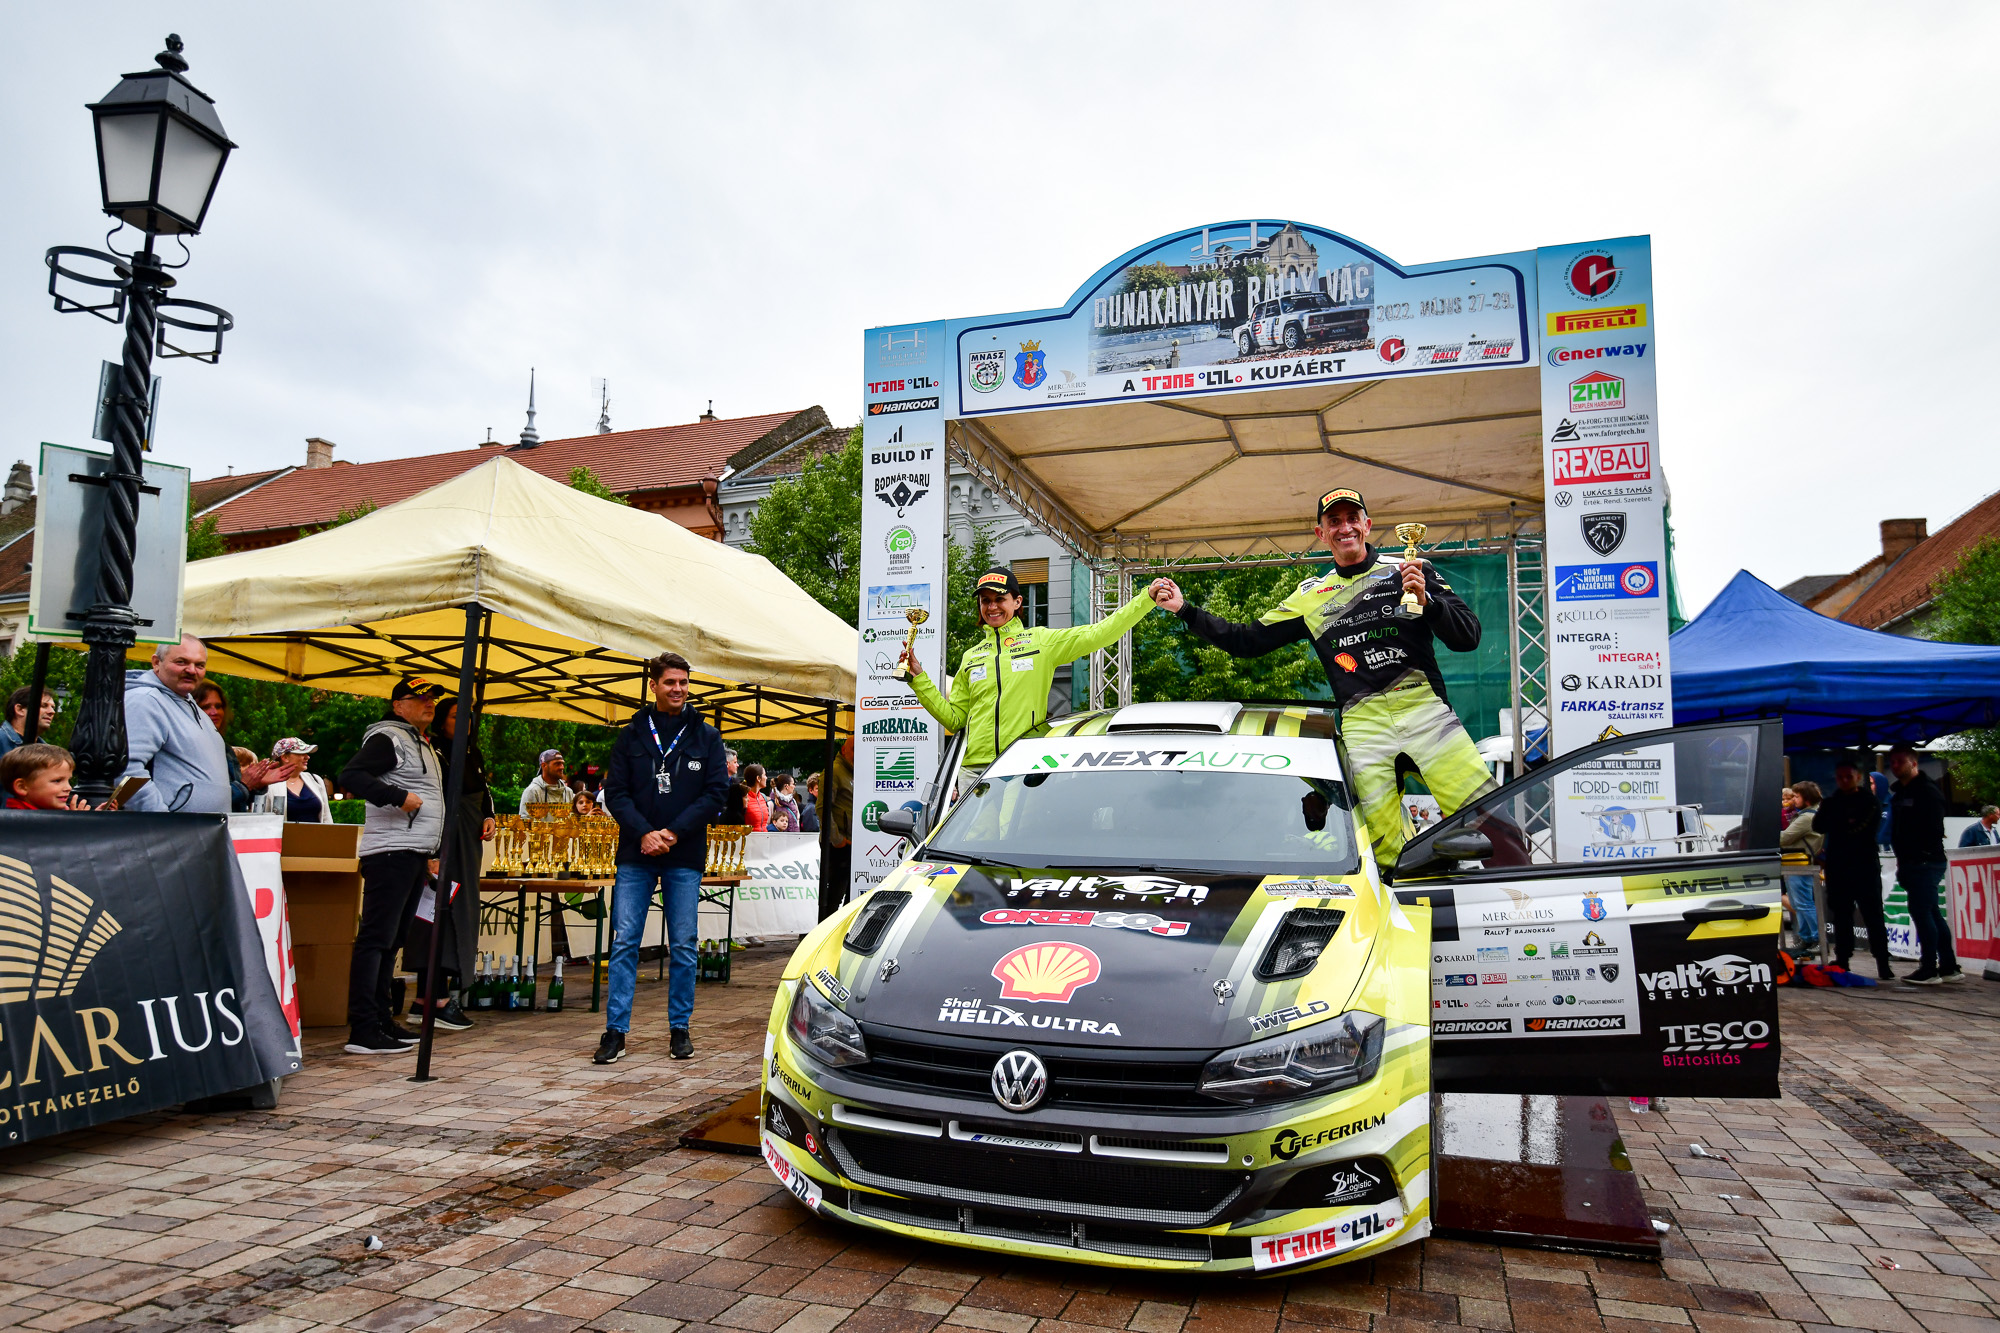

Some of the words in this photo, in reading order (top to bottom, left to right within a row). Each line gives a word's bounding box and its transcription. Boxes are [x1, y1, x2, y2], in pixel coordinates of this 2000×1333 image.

[1094, 279, 1235, 328] DUNAKANYAR
[1248, 271, 1317, 319] RALLY
[1376, 302, 1414, 322] 2022.
[1556, 308, 1638, 332] PIRELLI
[970, 351, 1005, 362] MNASZ
[1432, 351, 1460, 360] RALLY
[1483, 346, 1512, 355] RALLY
[1559, 343, 1647, 362] enerway
[1122, 380, 1136, 392] A
[1251, 358, 1346, 381] KUPÁÉRT
[1572, 381, 1621, 402] ZHW
[1572, 401, 1594, 410] ZEMPLÉN
[1594, 399, 1623, 408] HARD-WORK
[1578, 416, 1619, 426] FA-FORG-TECH
[1583, 427, 1646, 438] www.faforgtech.hu
[871, 450, 916, 465] BUILD
[920, 448, 934, 461] IT
[1554, 446, 1646, 480] REXBAU
[874, 472, 930, 493] BODNÁR-DARU
[1582, 488, 1612, 497] LUKÁCS
[1614, 486, 1624, 495] ÉS
[1625, 484, 1653, 493] TAMÁS
[1623, 495, 1653, 503] Szeretet.
[1584, 515, 1622, 523] PEUGEOT
[1583, 567, 1600, 576] HOGY
[1583, 574, 1615, 582] MINDENKI
[1577, 581, 1615, 590] HAZAÉRJEN!
[1563, 608, 1607, 623] KÜLLŐ
[1338, 626, 1399, 648] NEXTAUTO
[1557, 632, 1611, 643] INTEGRA
[1364, 646, 1408, 665] HELIX
[1586, 674, 1663, 689] KARADI
[865, 697, 889, 707] DÓSA
[1560, 700, 1665, 712] FARKAS-transz
[1607, 712, 1648, 720] SZÁLLÍTÁSI
[862, 717, 928, 735] HERBATÁR
[688, 761, 702, 771] FIA
[1072, 750, 1292, 770] NEXTAUTO
[1603, 760, 1624, 769] WELL
[1626, 760, 1642, 769] BAU
[1644, 760, 1660, 769] KFT.
[876, 780, 915, 789] PERLA-X
[1573, 780, 1660, 795] NORD-ORIENT
[1582, 845, 1626, 858] EVIZA
[1631, 846, 1657, 858] KFT
[1662, 873, 1771, 896] iWELD
[1007, 890, 1205, 906] SECURITY
[981, 909, 1163, 930] ORBICO
[1482, 909, 1554, 922] MERCARIUS
[1514, 927, 1556, 935] BAJNOKSÁG
[1444, 954, 1475, 963] KARADI
[1481, 973, 1507, 983] REXBAU
[1551, 969, 1580, 977] DREXLER
[1648, 982, 1772, 1001] SECURITY
[942, 997, 982, 1009] Shell
[938, 1004, 1030, 1027] HELIX
[1031, 1015, 1122, 1037] ULTRA
[1659, 1020, 1770, 1044] TESCO
[1662, 1052, 1741, 1067] Biztosítás
[1288, 1111, 1387, 1152] FE-FERRUM
